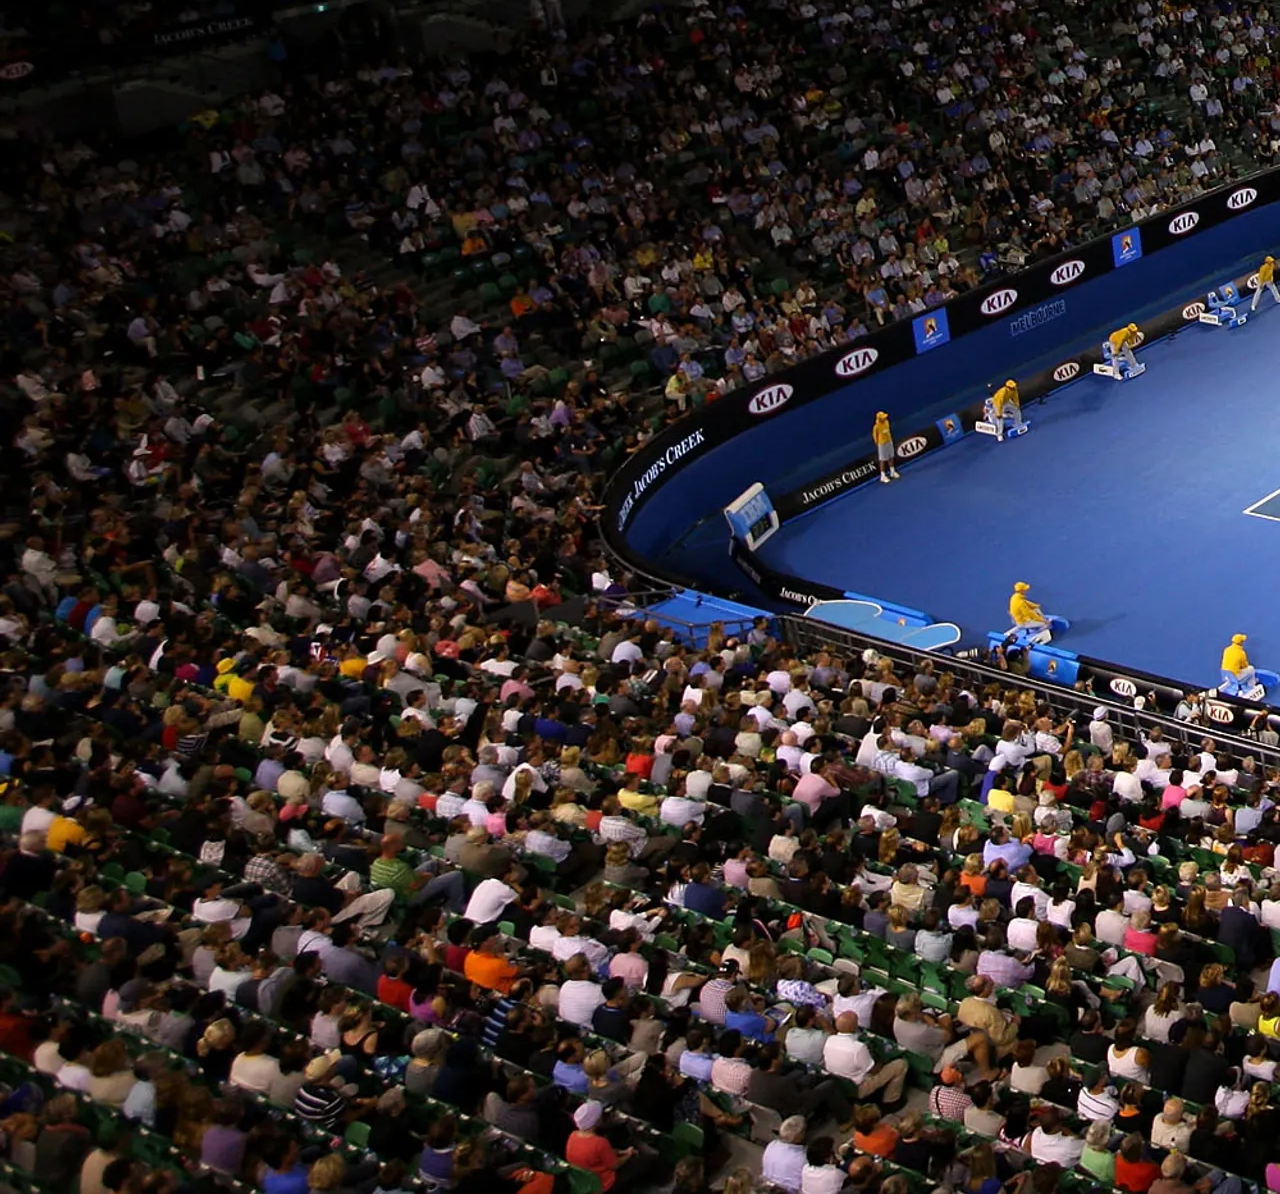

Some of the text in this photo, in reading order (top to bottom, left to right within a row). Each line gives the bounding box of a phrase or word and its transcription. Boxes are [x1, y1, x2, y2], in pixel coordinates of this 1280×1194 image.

[1231, 190, 1254, 205] KIA
[1173, 215, 1196, 231] KIA
[1055, 263, 1081, 281] KIA
[985, 292, 1014, 311] KIA
[1010, 299, 1066, 336] MELBOURNE
[1185, 305, 1204, 318] KIA
[841, 352, 874, 373] KIA
[1056, 364, 1078, 380] KIA
[753, 388, 788, 411] KIA
[901, 440, 925, 456] KIA
[634, 428, 705, 499] JACOB'S CREEK
[801, 460, 877, 504] JACOB'S CREEK
[779, 587, 808, 603] JACOB'S
[1113, 680, 1133, 694] KIA
[1209, 707, 1230, 722] KIA
